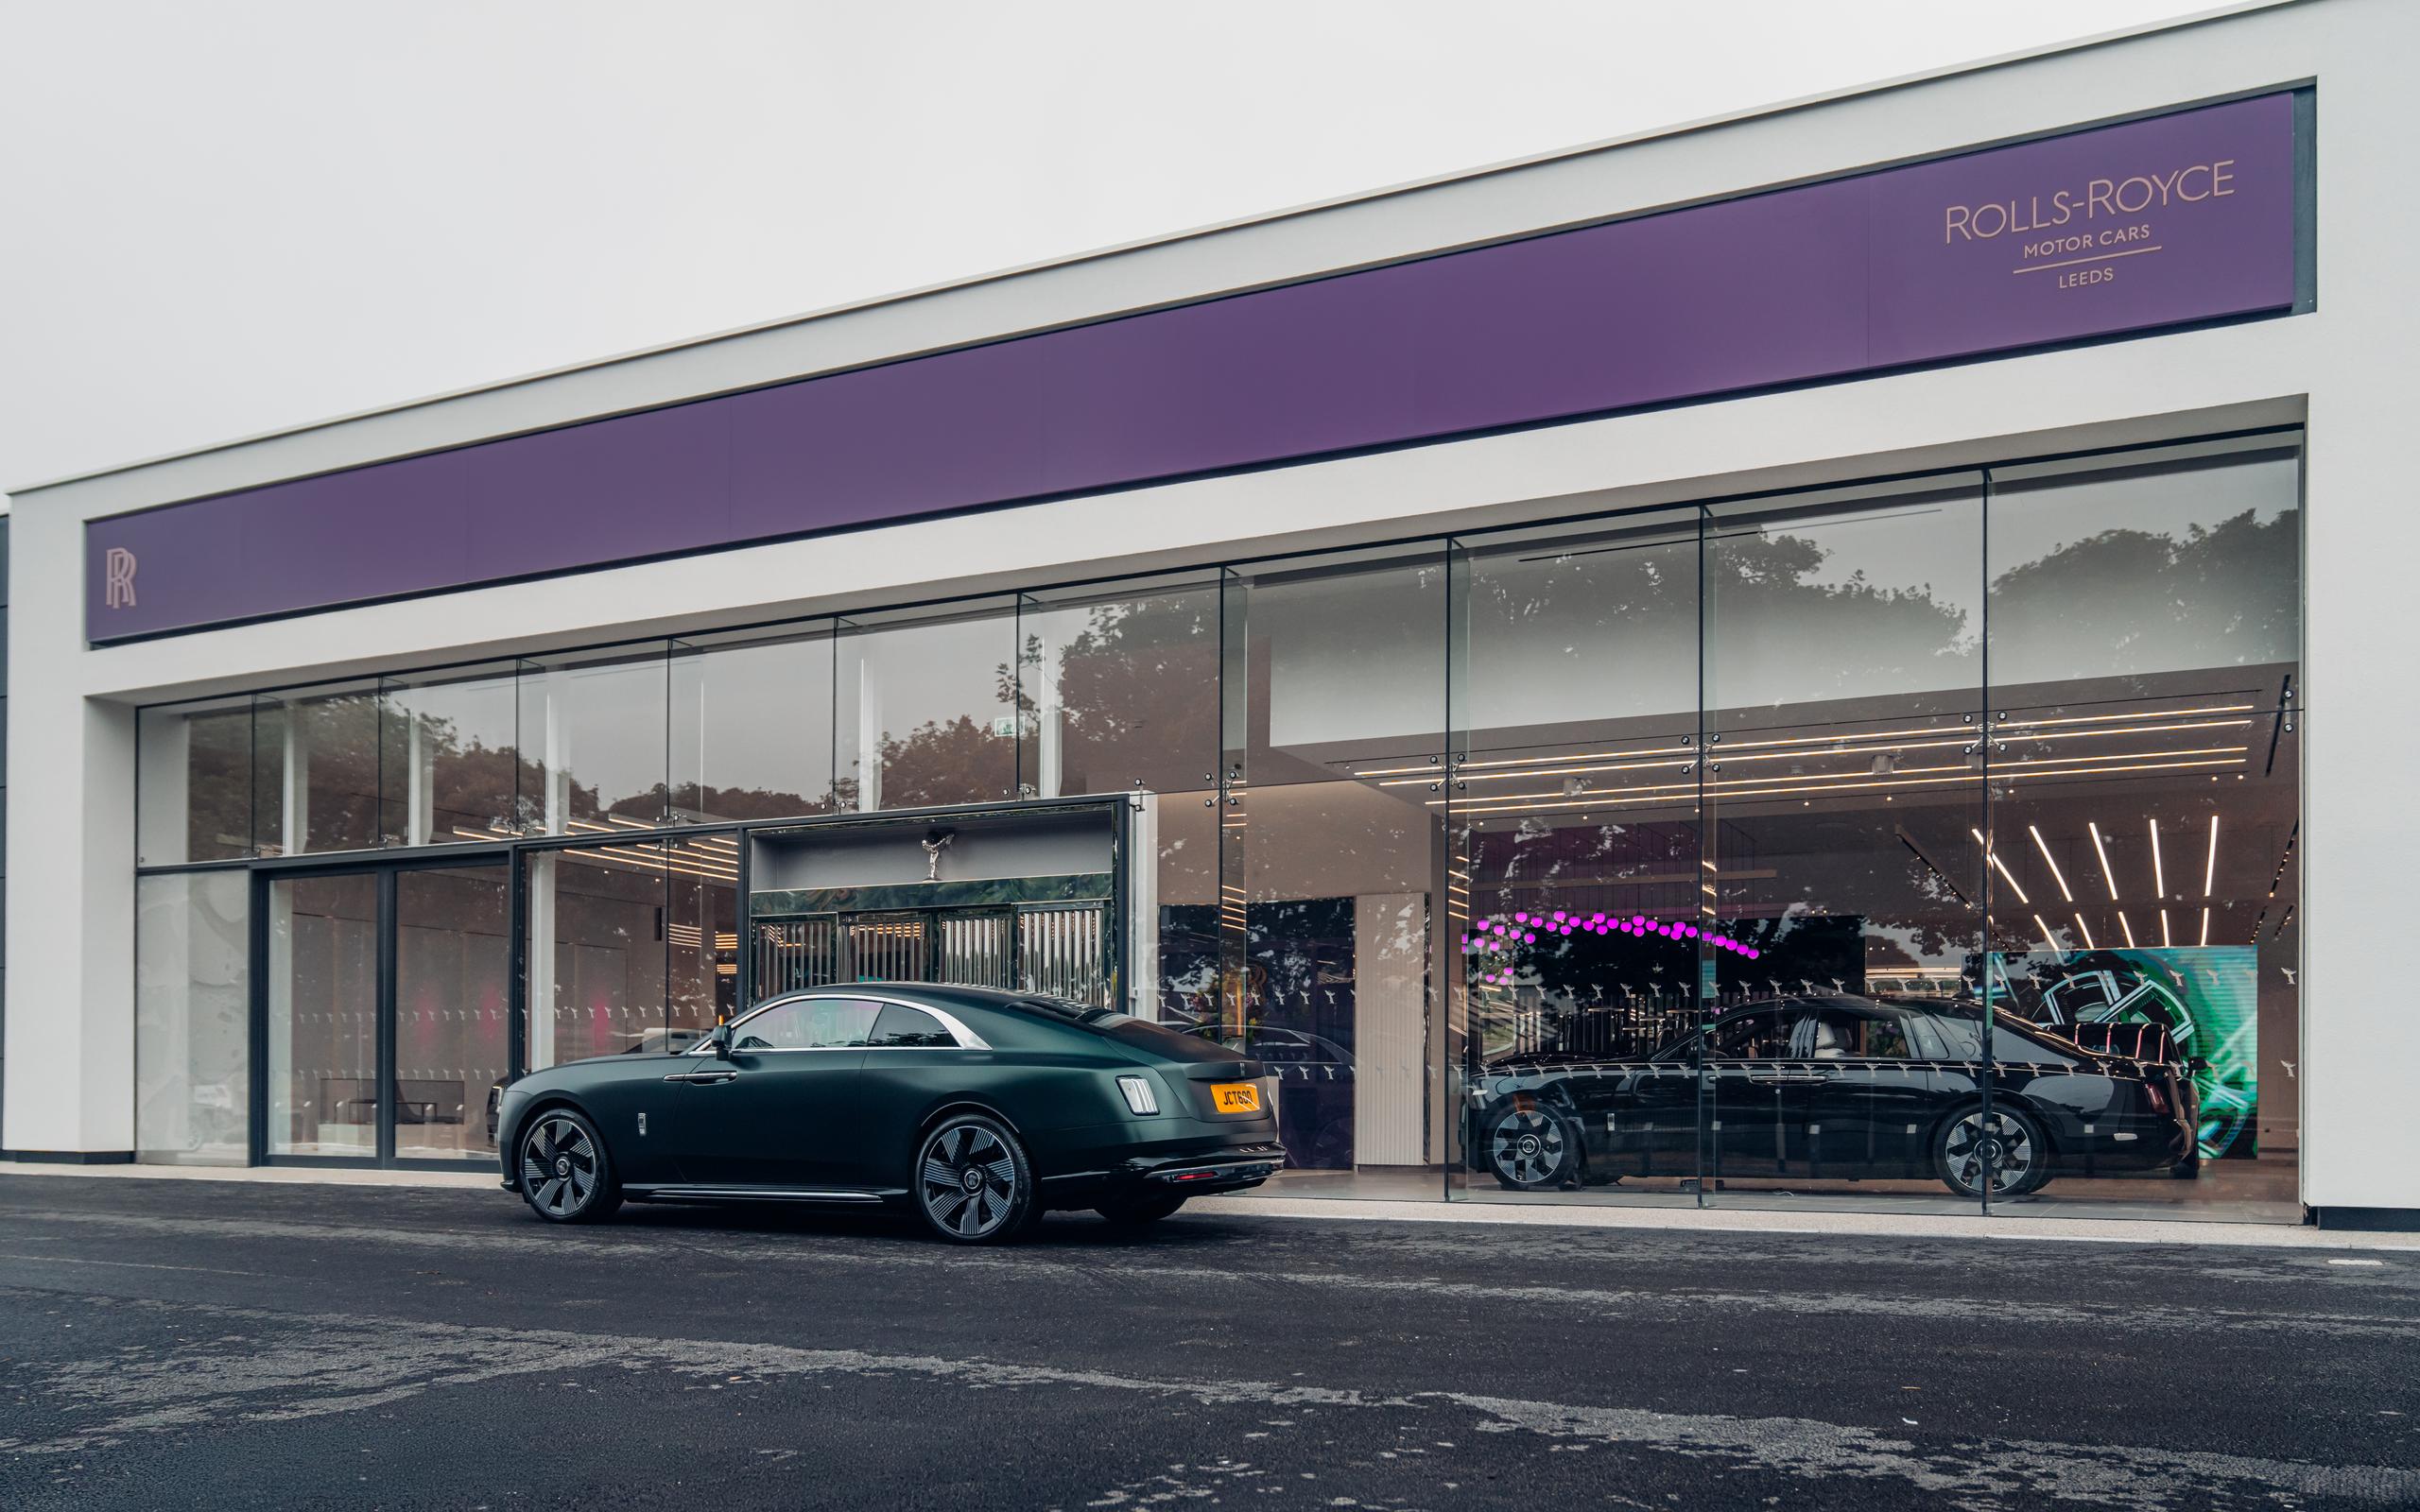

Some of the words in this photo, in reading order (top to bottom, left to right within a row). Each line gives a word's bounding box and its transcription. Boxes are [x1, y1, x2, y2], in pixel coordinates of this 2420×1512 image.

[1946, 159, 2235, 245] ROLLS-ROYCE
[2024, 233, 2094, 259] MOTOR
[2099, 224, 2151, 246] CARS
[2059, 267, 2114, 289] LEEDS
